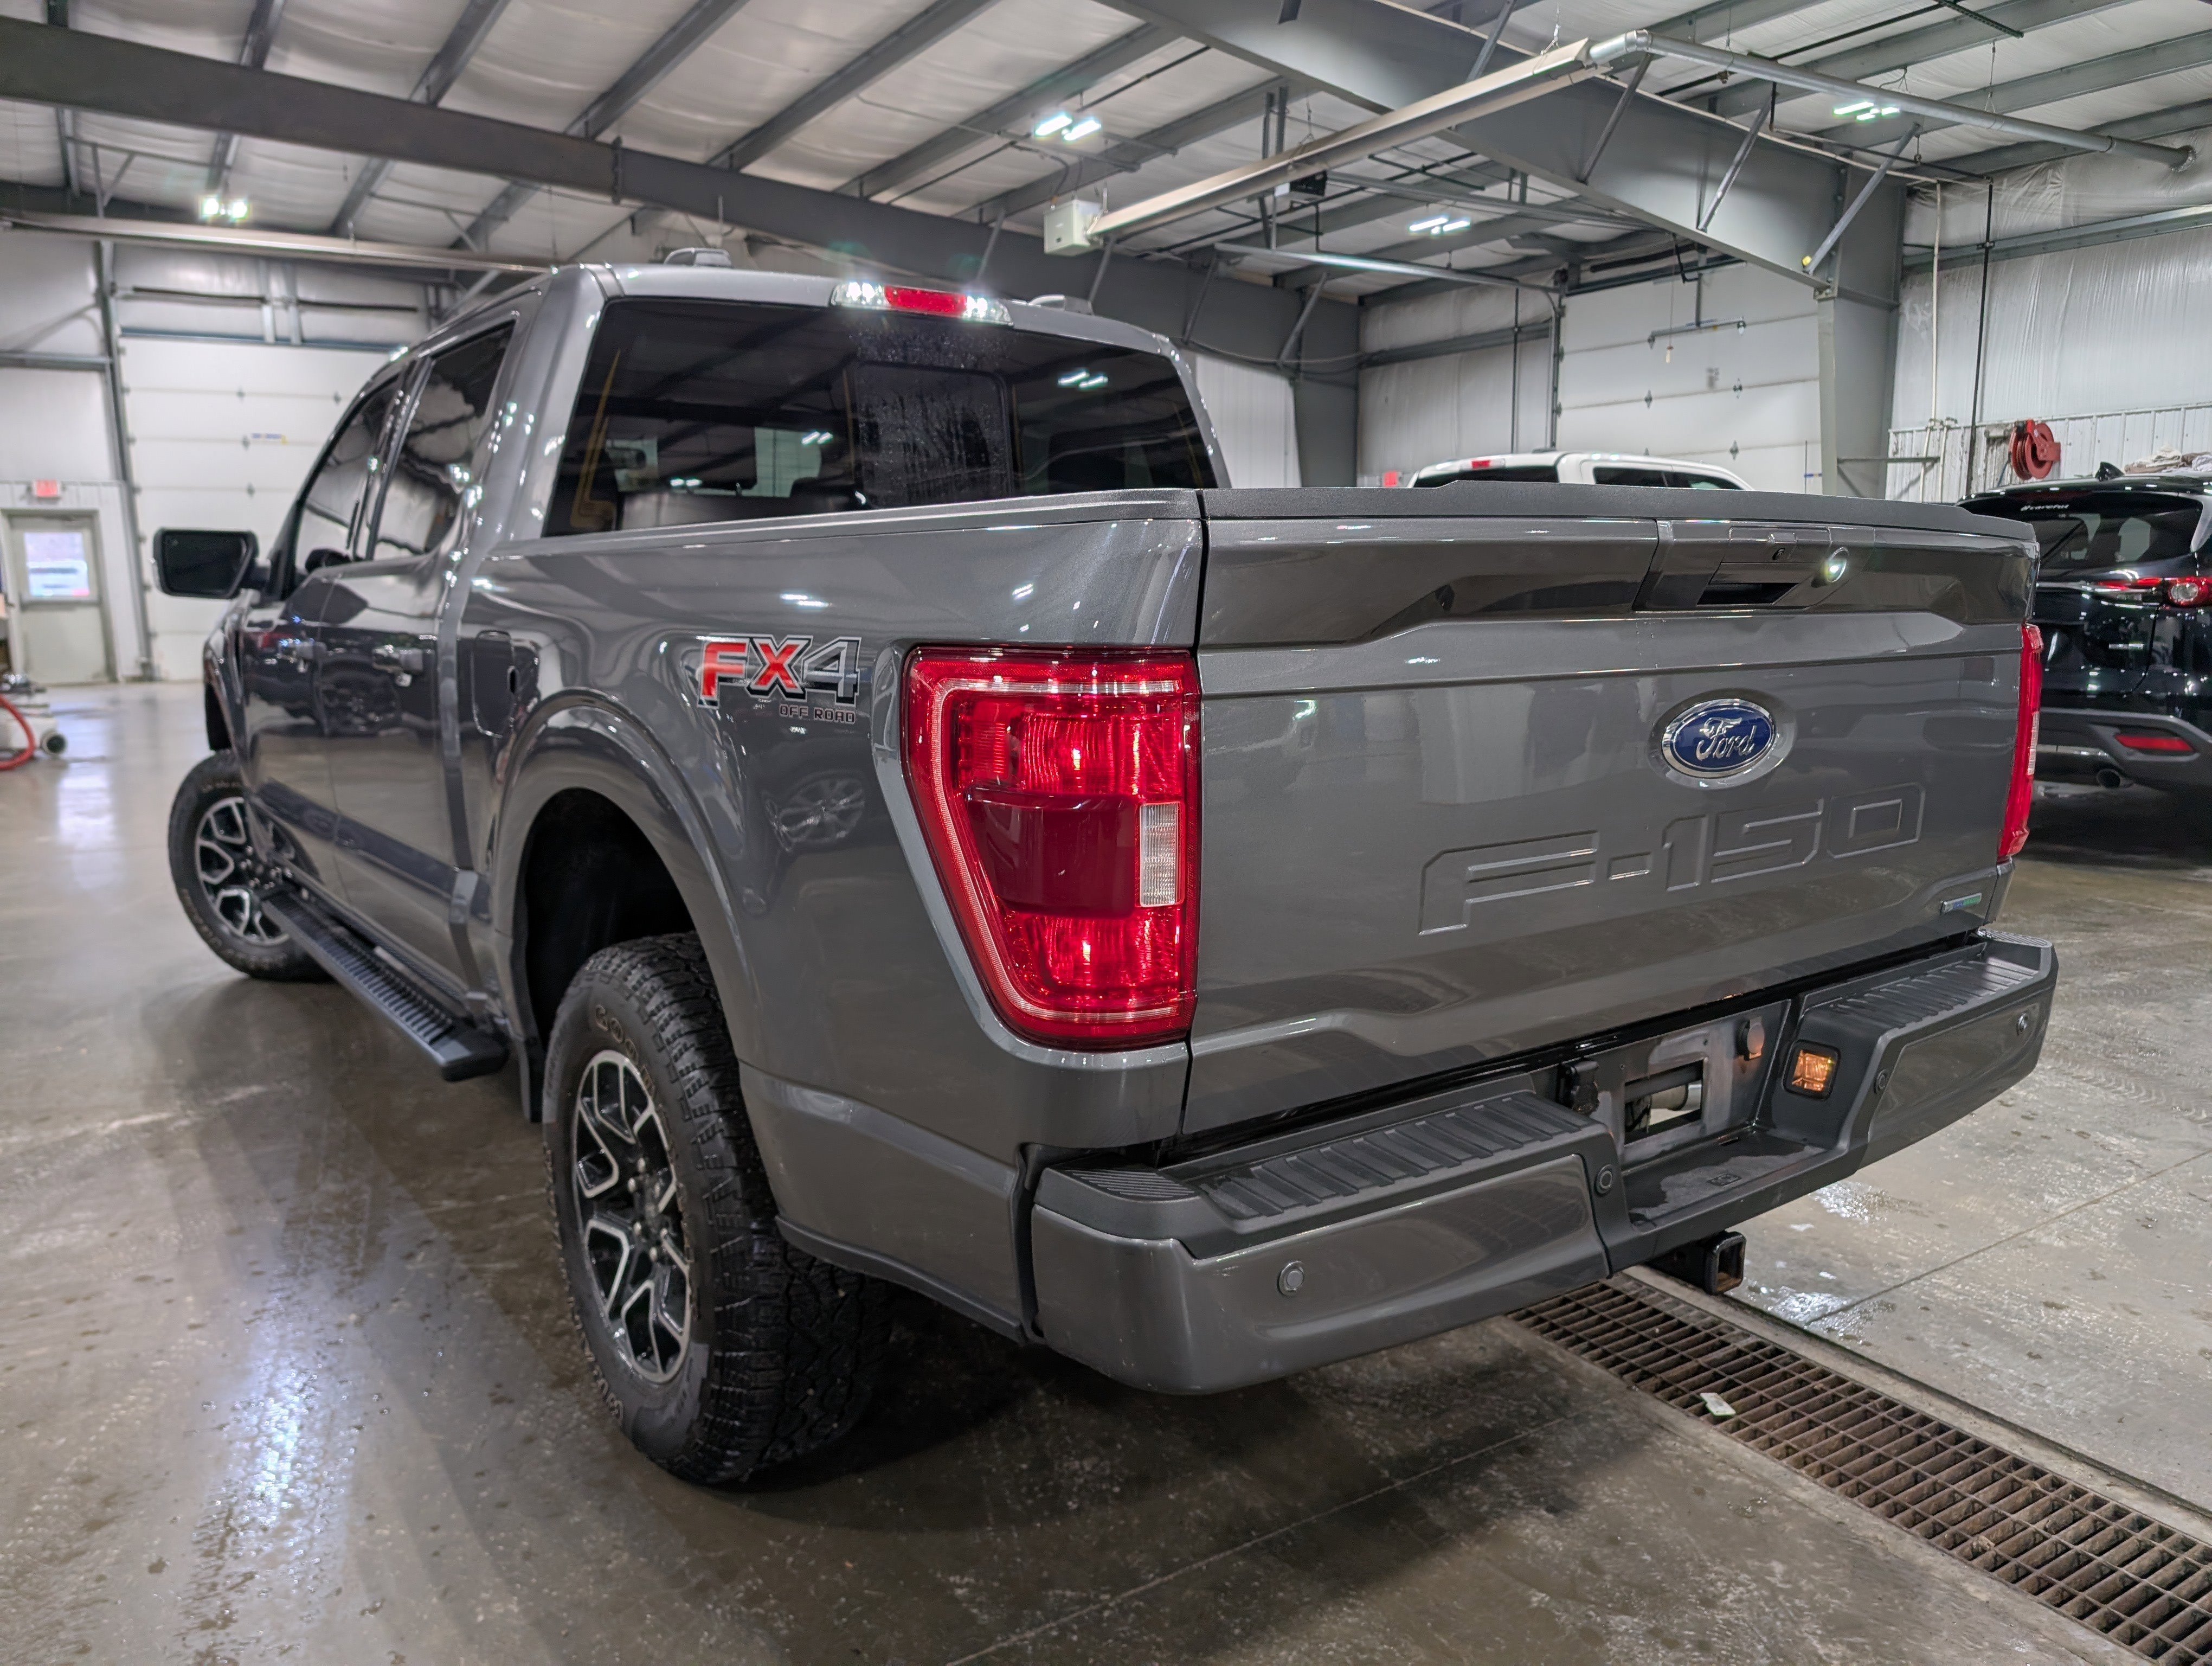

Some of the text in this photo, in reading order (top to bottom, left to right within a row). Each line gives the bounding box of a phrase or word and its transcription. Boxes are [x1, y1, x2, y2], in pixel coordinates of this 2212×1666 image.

[697, 632, 861, 708] FX4
[779, 704, 856, 725] OFF ROAD
[1696, 716, 1756, 761] Ford
[1418, 783, 1926, 937] F-150
